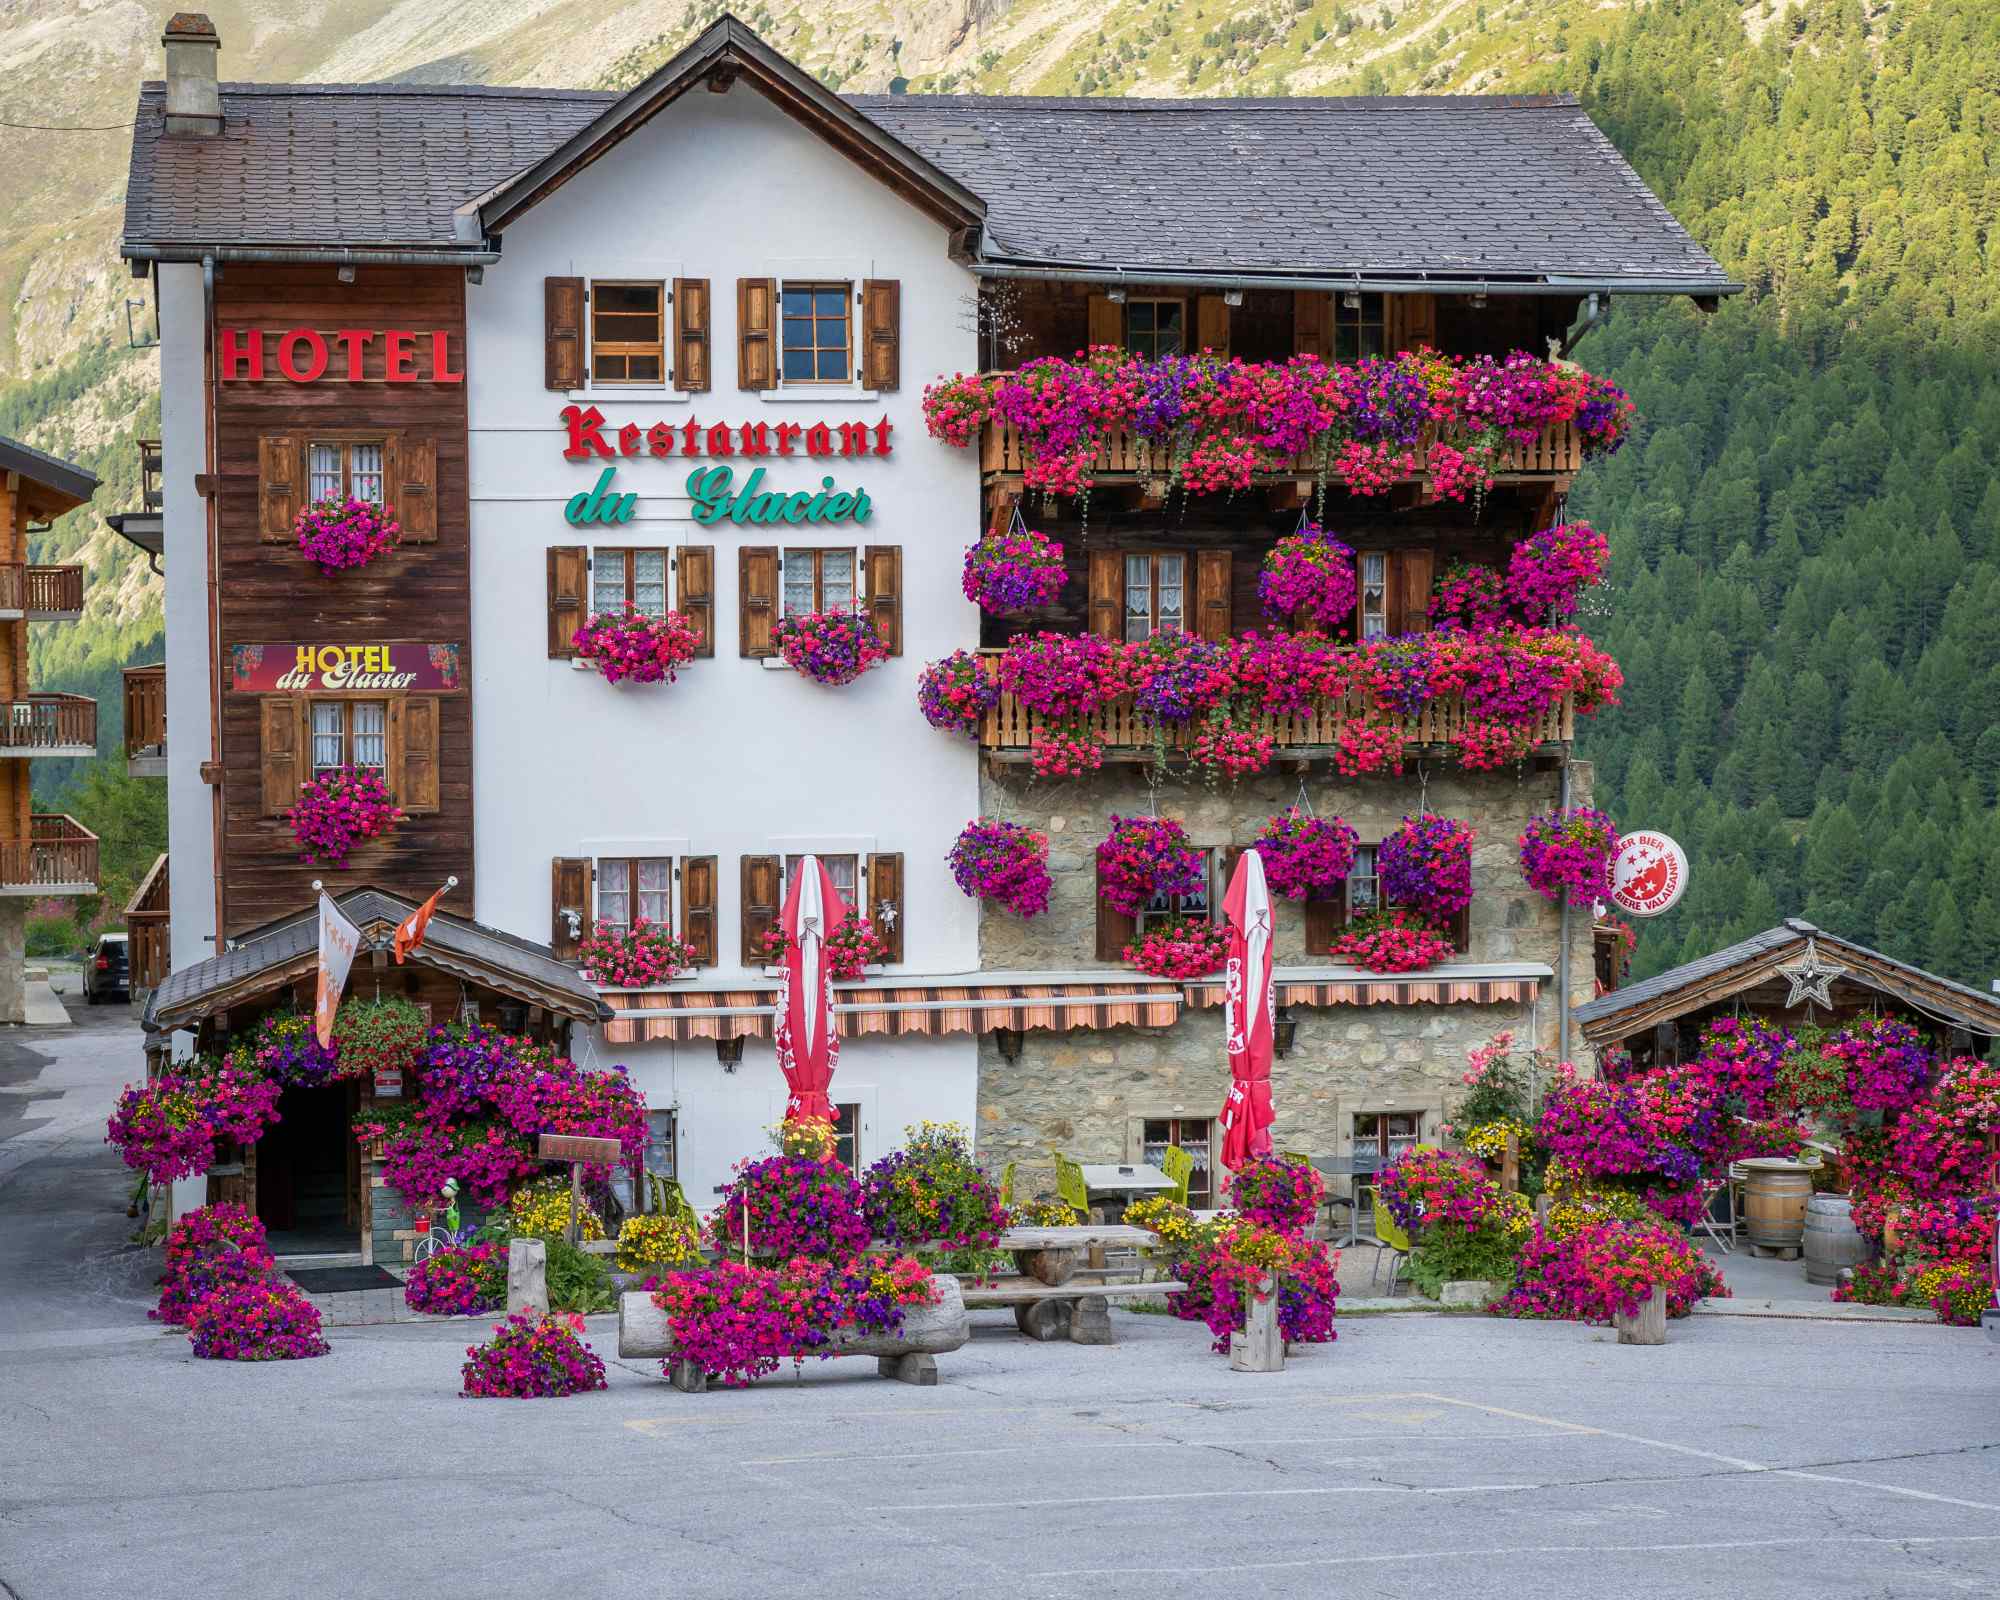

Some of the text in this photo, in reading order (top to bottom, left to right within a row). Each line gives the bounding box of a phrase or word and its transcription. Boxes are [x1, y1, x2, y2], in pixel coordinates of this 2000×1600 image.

[220, 327, 465, 383] HOTEL
[560, 404, 894, 460] Restaurant
[564, 465, 873, 526] du Glacier
[275, 660, 417, 690] du Glacier
[296, 646, 396, 674] HOTEL
[1639, 835, 1665, 851] BIER
[1614, 850, 1679, 911] BIERE VALAISANNE
